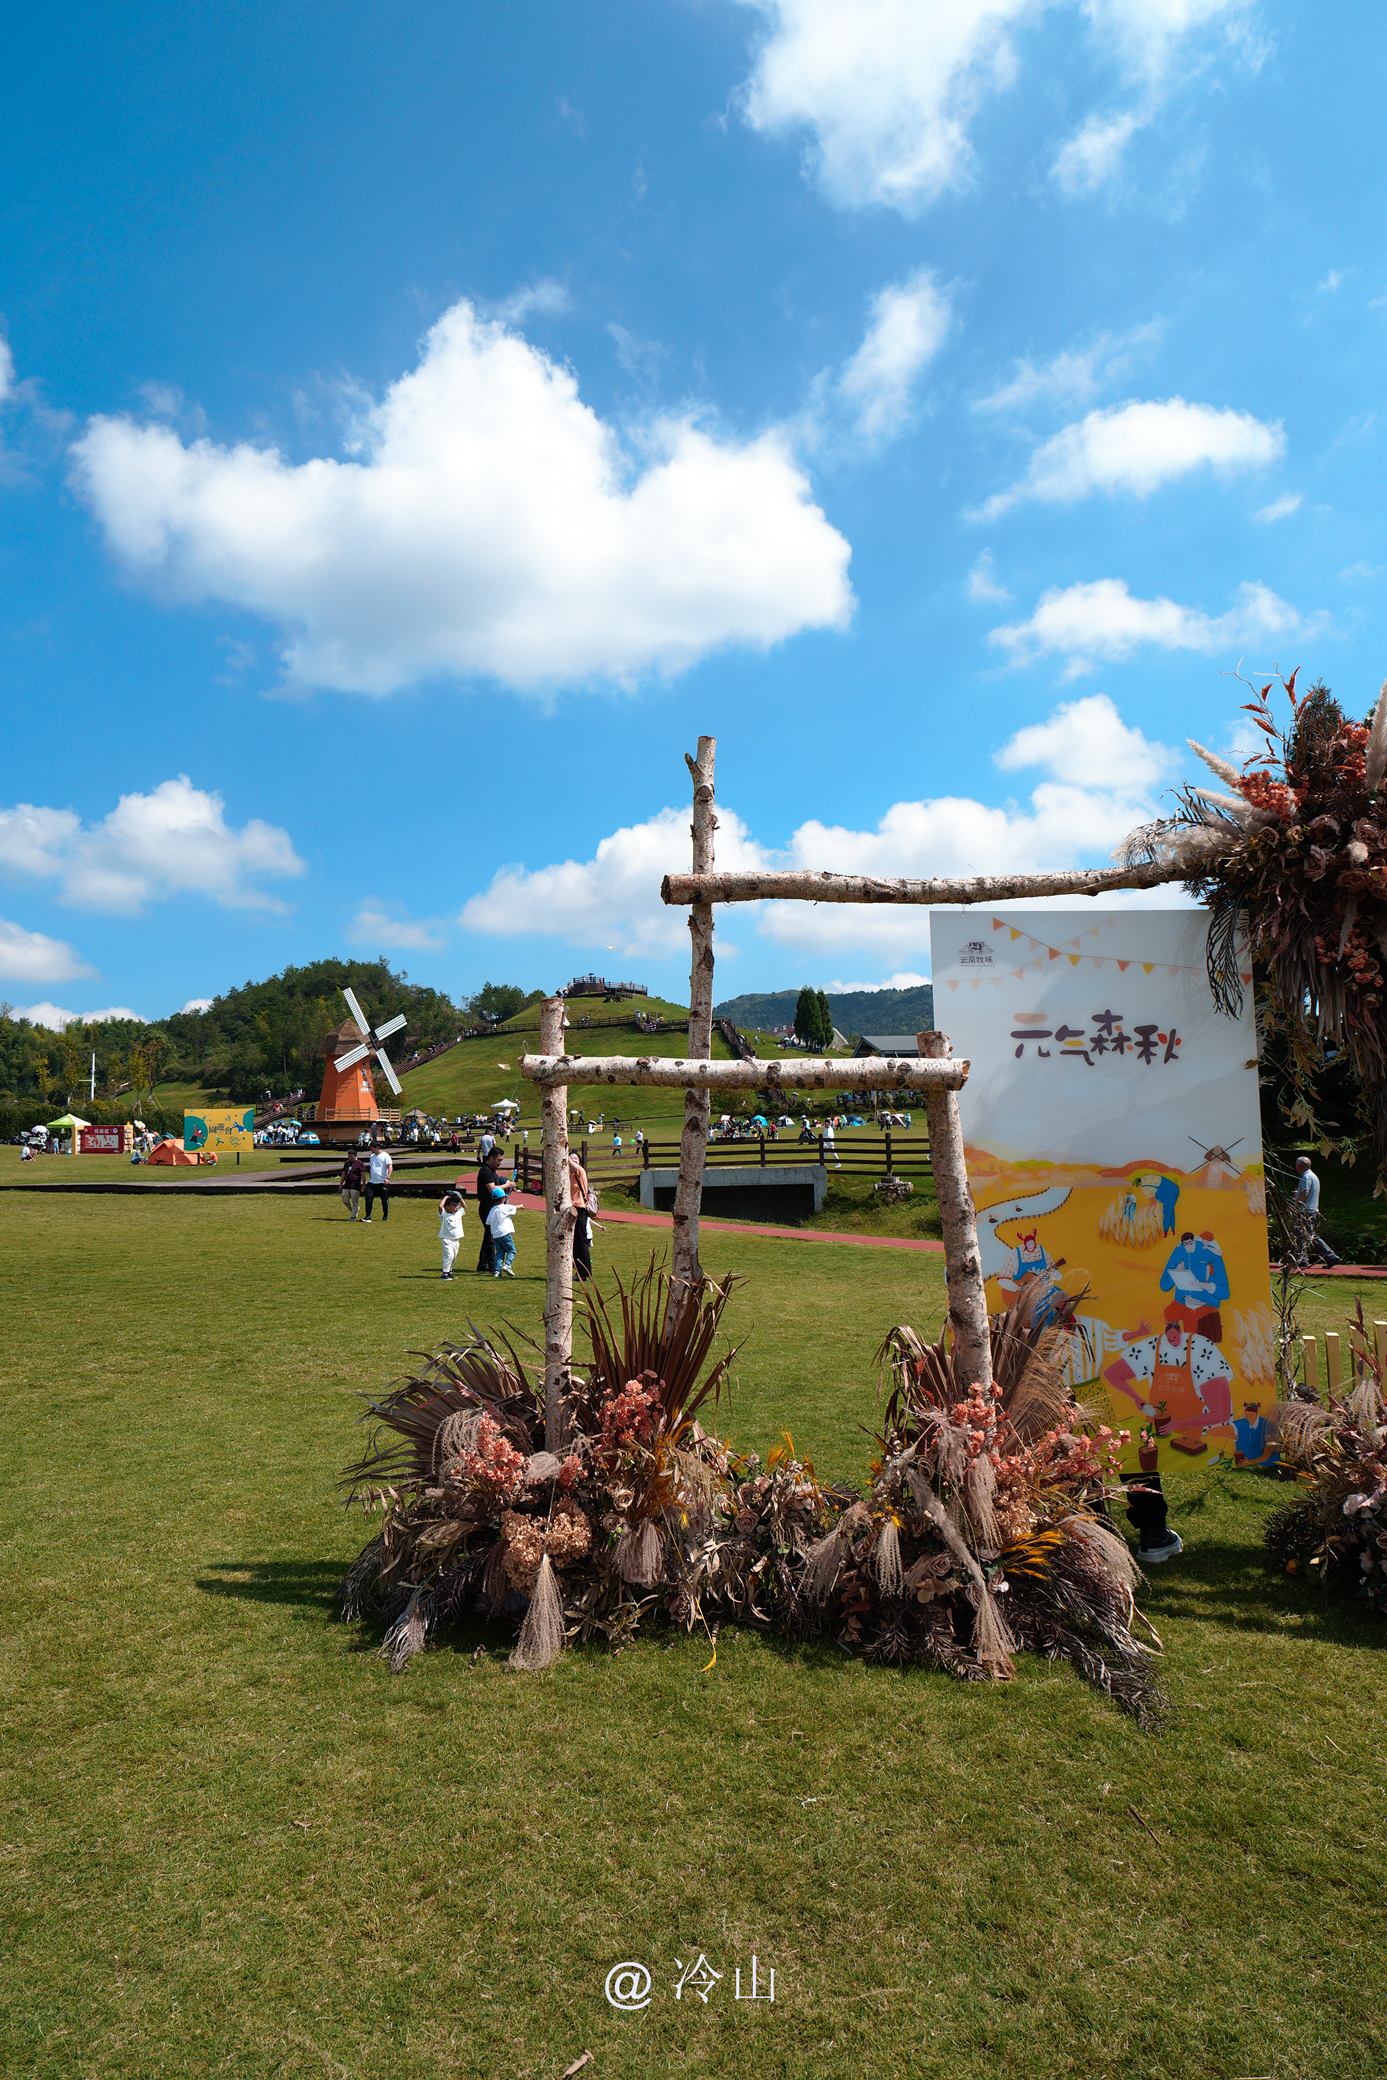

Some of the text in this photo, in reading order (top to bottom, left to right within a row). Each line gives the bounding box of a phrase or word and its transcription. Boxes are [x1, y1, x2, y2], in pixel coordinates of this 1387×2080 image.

[960, 955, 994, 964] 云岚牧场
[1010, 1009, 1182, 1067] 元气森秋
